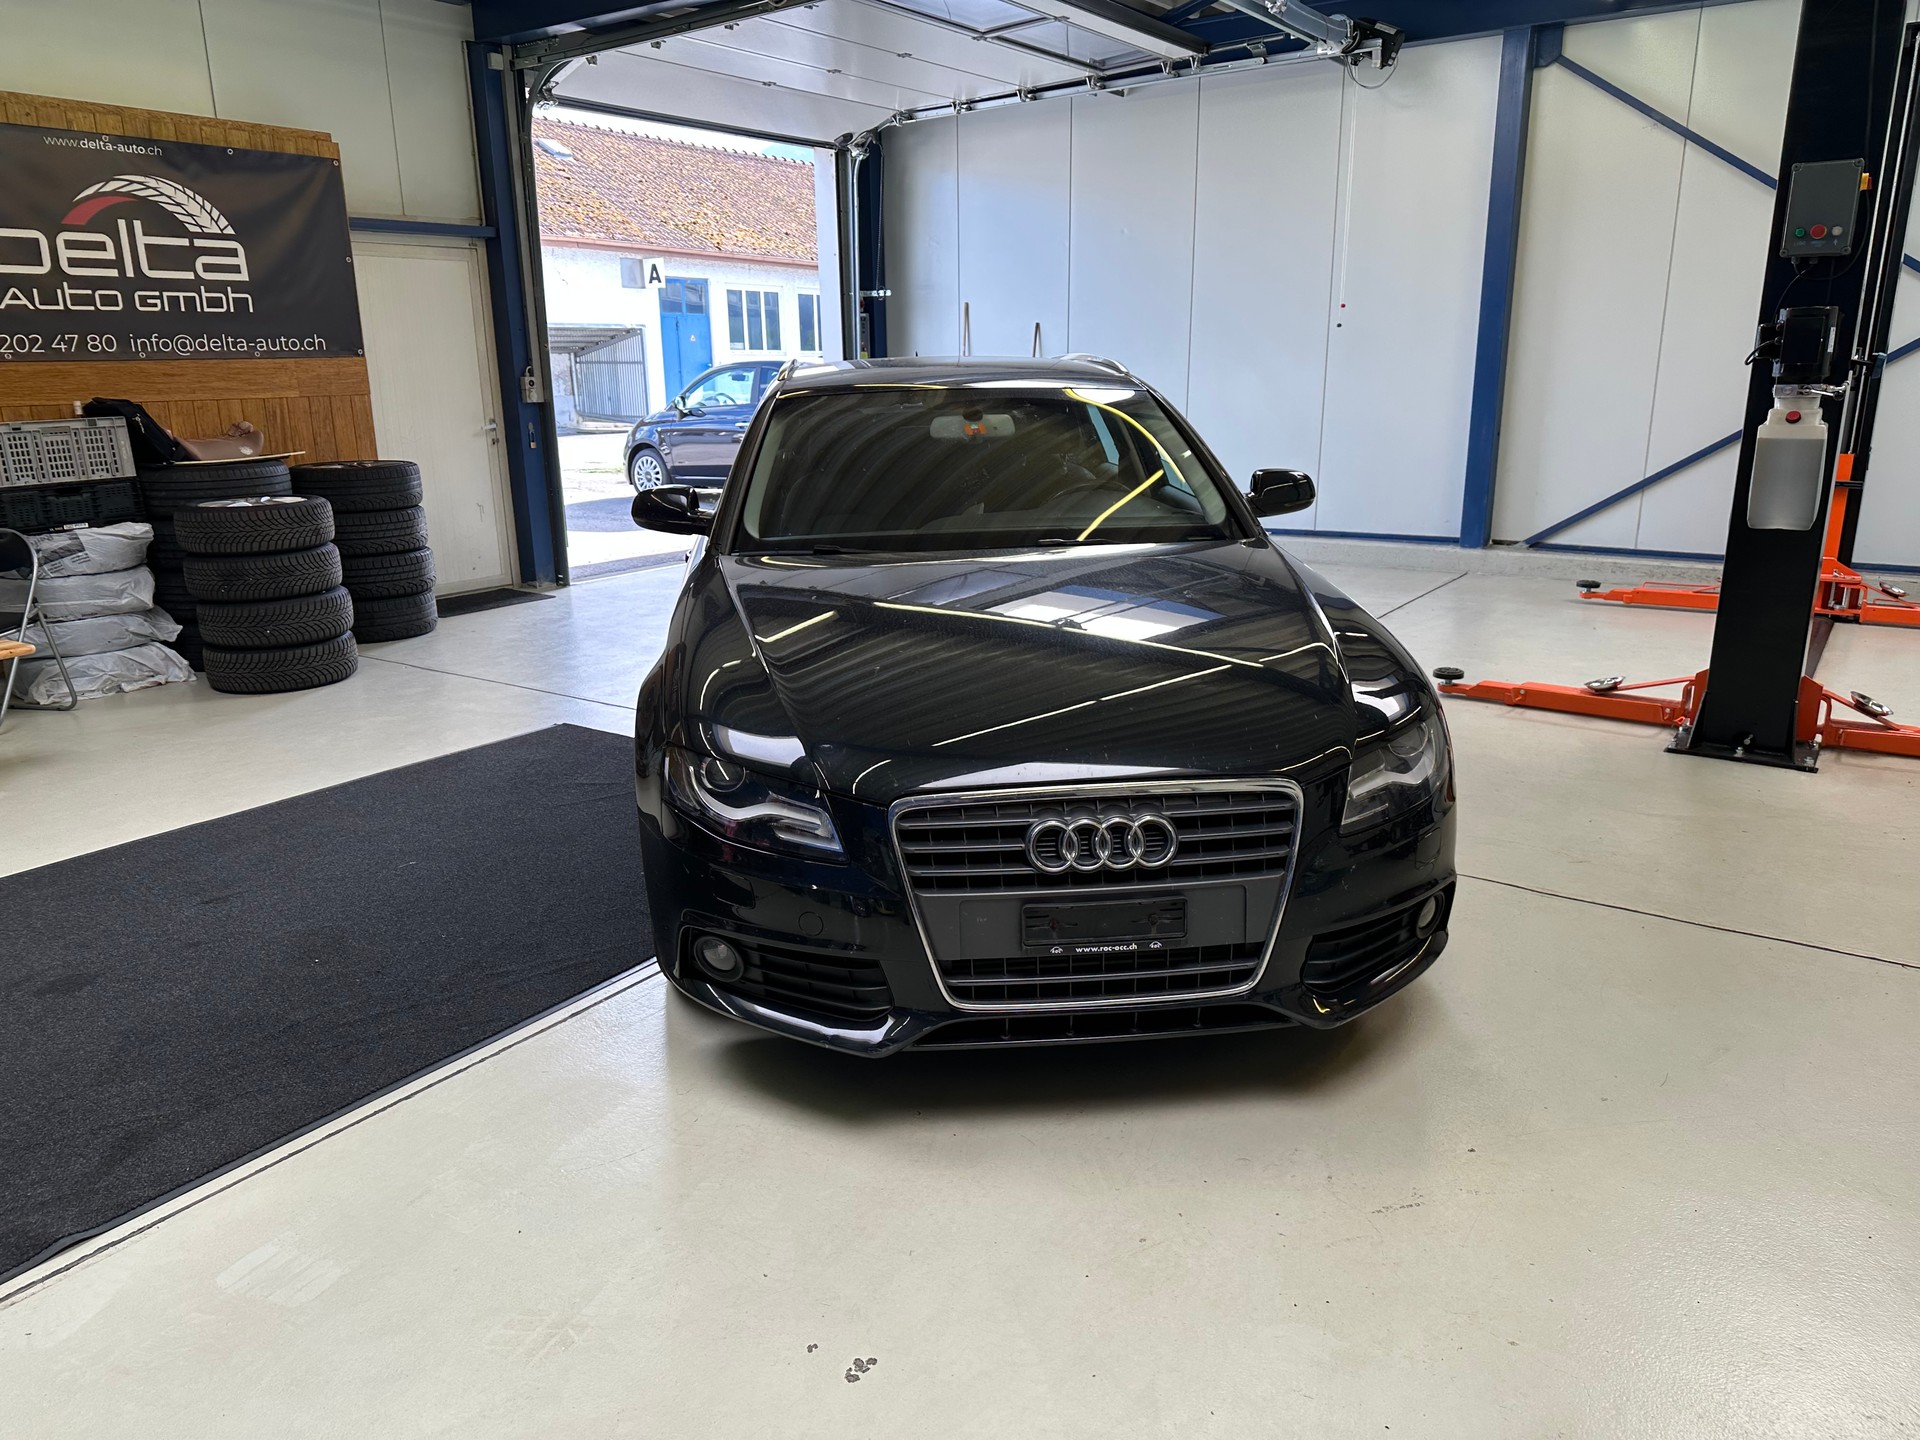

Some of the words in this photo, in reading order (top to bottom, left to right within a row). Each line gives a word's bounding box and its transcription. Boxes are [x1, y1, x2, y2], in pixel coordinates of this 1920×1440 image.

[43, 136, 162, 156] www.delta-auto.ch
[649, 263, 662, 284] A
[0, 282, 123, 311] Auto
[0, 334, 45, 353] 202
[51, 334, 79, 353] 47
[86, 334, 117, 353] 80
[129, 334, 326, 356] info@delta-auto.ch
[1075, 943, 1138, 953] www.roc-occ.ch
